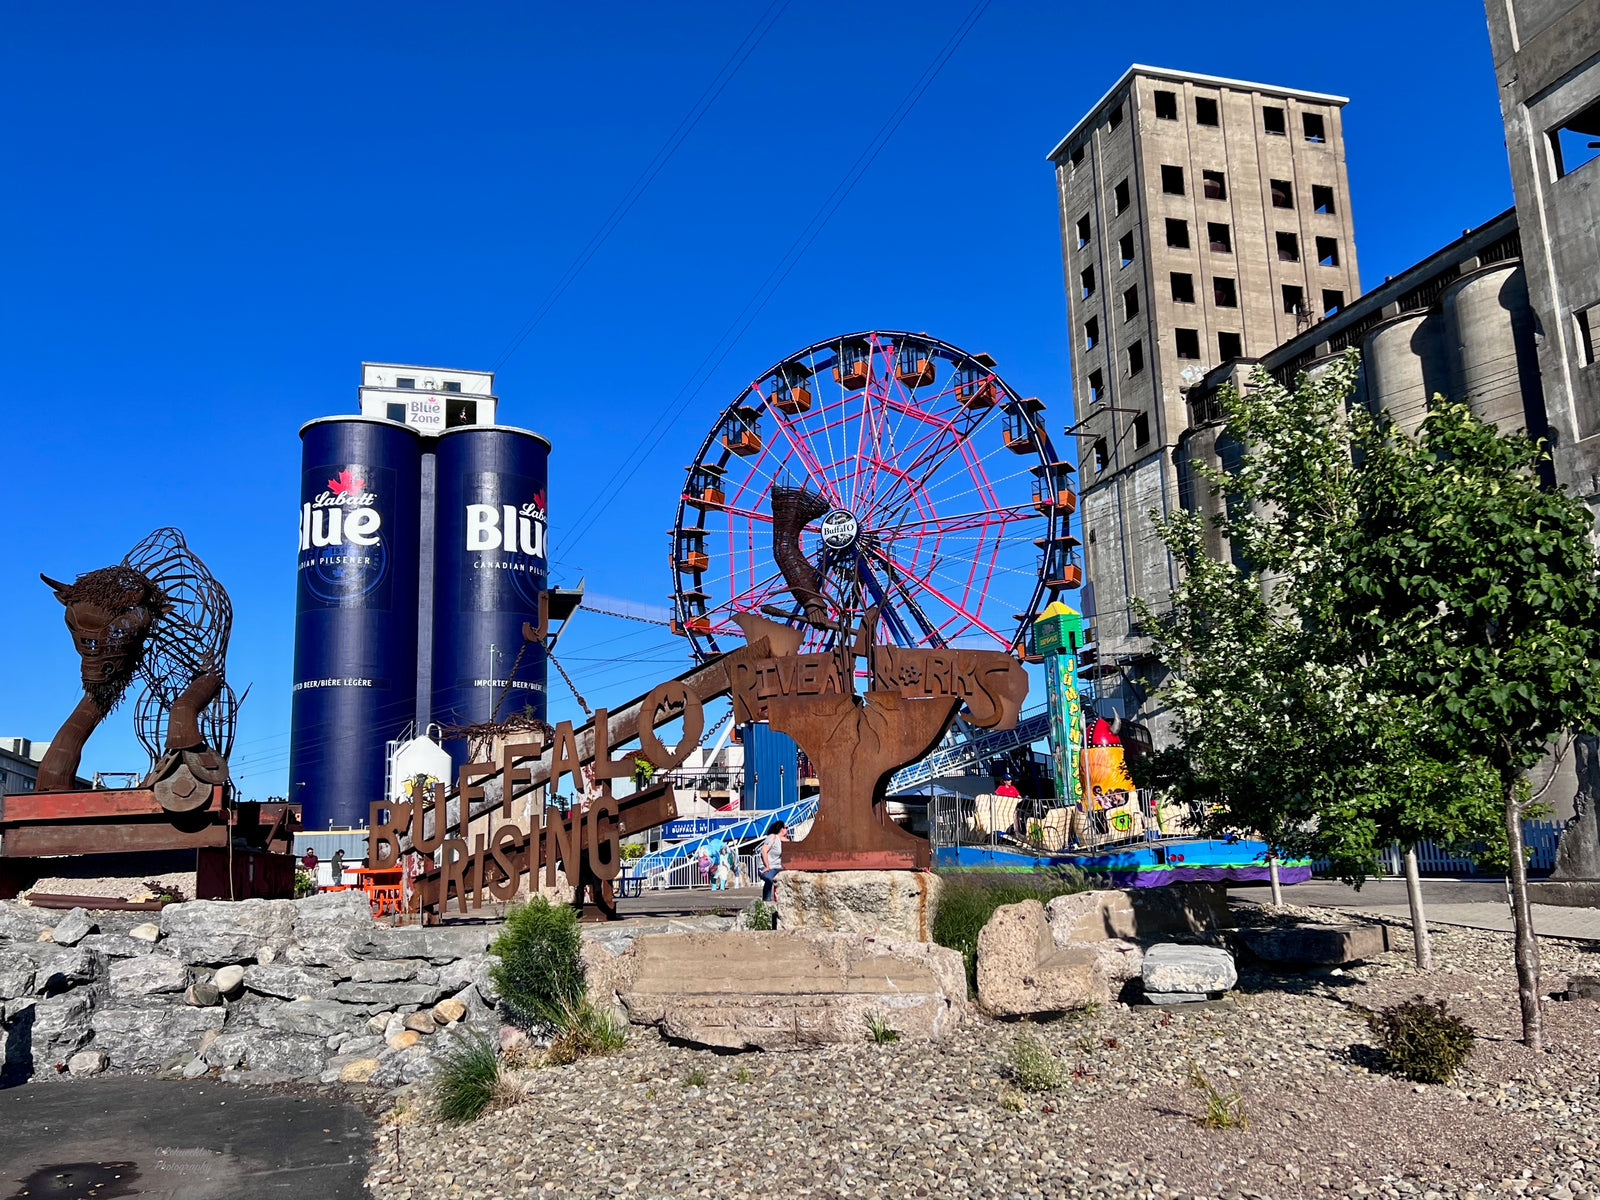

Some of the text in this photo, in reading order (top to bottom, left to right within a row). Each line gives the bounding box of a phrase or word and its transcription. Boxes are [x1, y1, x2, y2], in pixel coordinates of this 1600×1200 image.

[411, 401, 440, 413] Blue
[411, 412, 440, 424] Zone
[312, 490, 374, 508] Labatt
[466, 503, 548, 560] Blu
[319, 556, 371, 565] PILSENER
[473, 561, 525, 572] CANADIAN
[368, 680, 705, 870] BUFFALO
[438, 796, 621, 914] RISING
